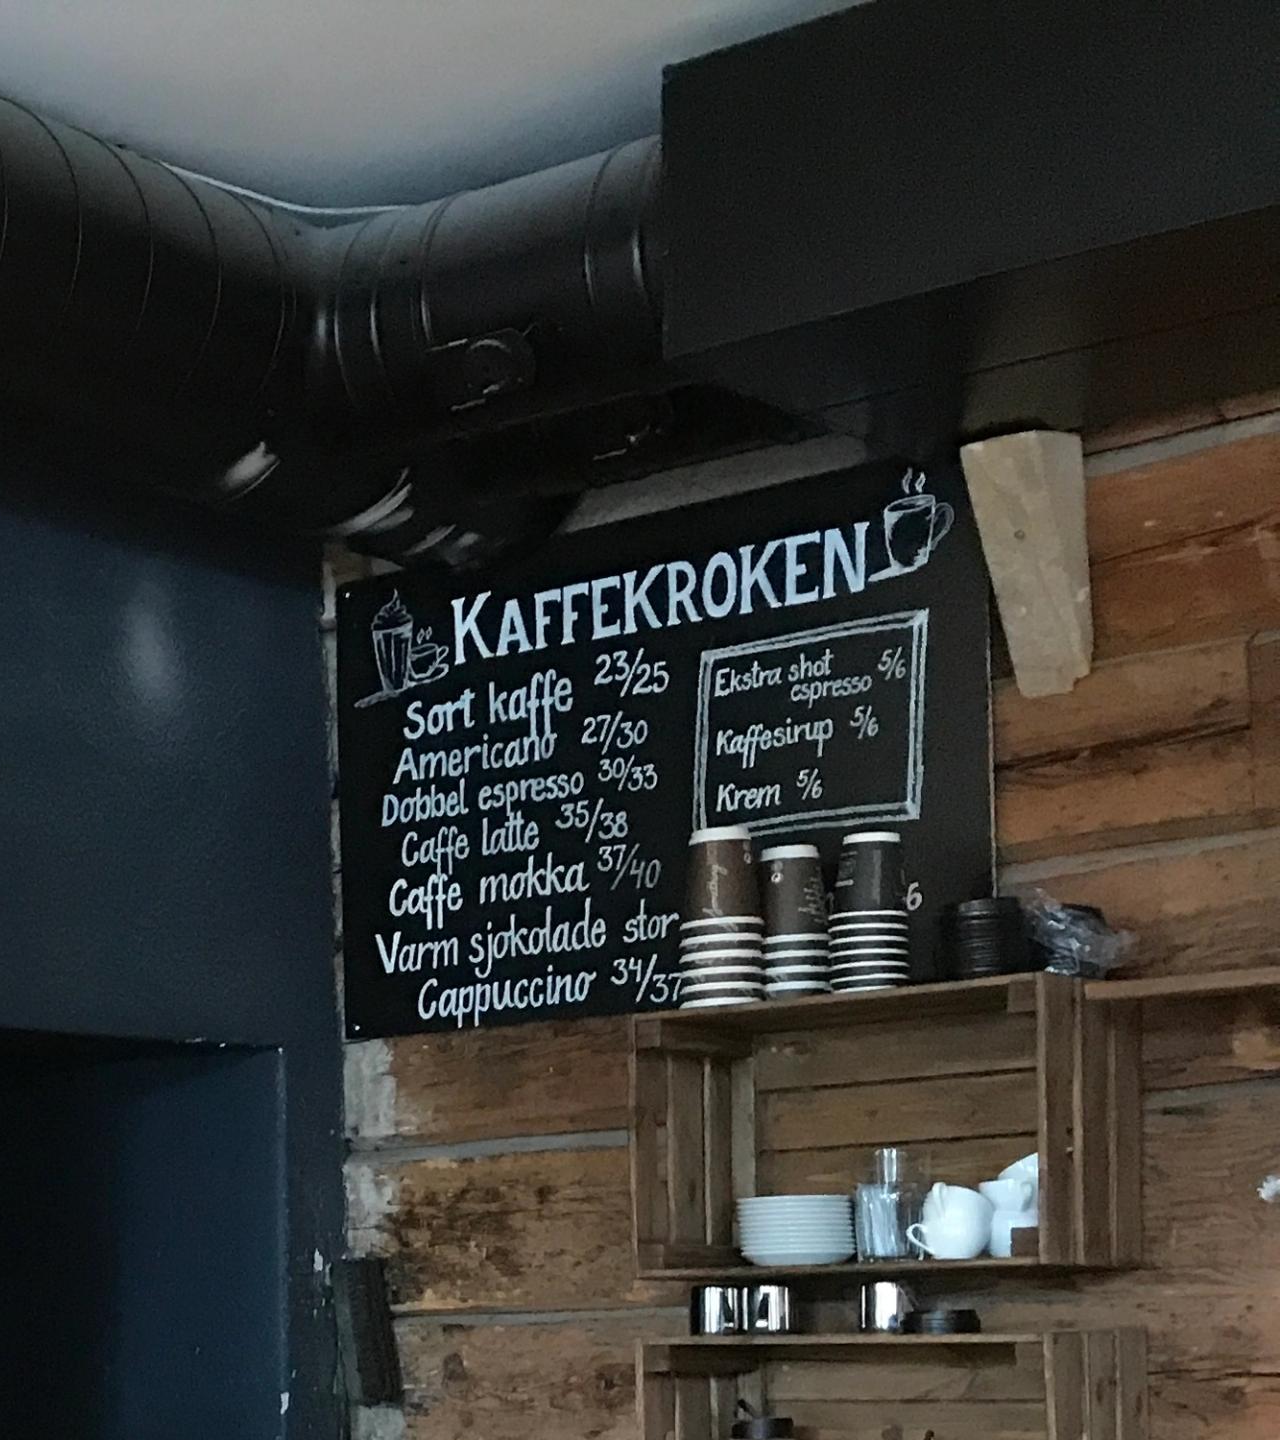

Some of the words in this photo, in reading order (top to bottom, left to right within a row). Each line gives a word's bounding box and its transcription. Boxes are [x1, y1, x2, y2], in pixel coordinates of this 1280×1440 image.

[451, 521, 871, 667] KAFFEKROKEN
[403, 688, 477, 740] Sort
[489, 668, 574, 738] kaffe
[593, 648, 671, 698] 23/25
[713, 660, 783, 698] Ekstra
[787, 648, 834, 682] shot
[790, 675, 873, 709] espresso
[877, 646, 907, 681] 5/6
[392, 733, 558, 785] Americano
[581, 710, 649, 755] 27/30
[715, 718, 835, 770] Kaffesirup
[849, 705, 879, 740] 5/6
[381, 777, 470, 828] Dobbel
[478, 771, 585, 817] espresso
[597, 754, 658, 791] 30/33
[715, 783, 782, 813] Krem
[796, 768, 824, 800] 5/6
[401, 825, 471, 876] Caffe
[481, 811, 541, 856] latte
[555, 798, 630, 844] 35/38
[388, 873, 464, 931] Caffe
[479, 851, 590, 905] mokka
[596, 843, 663, 891] 37/40
[374, 930, 459, 975] Varm
[468, 897, 607, 980] sjokolade
[621, 898, 680, 944] stor
[417, 964, 598, 1029] Cappuccino
[609, 953, 684, 1004] 34/37
